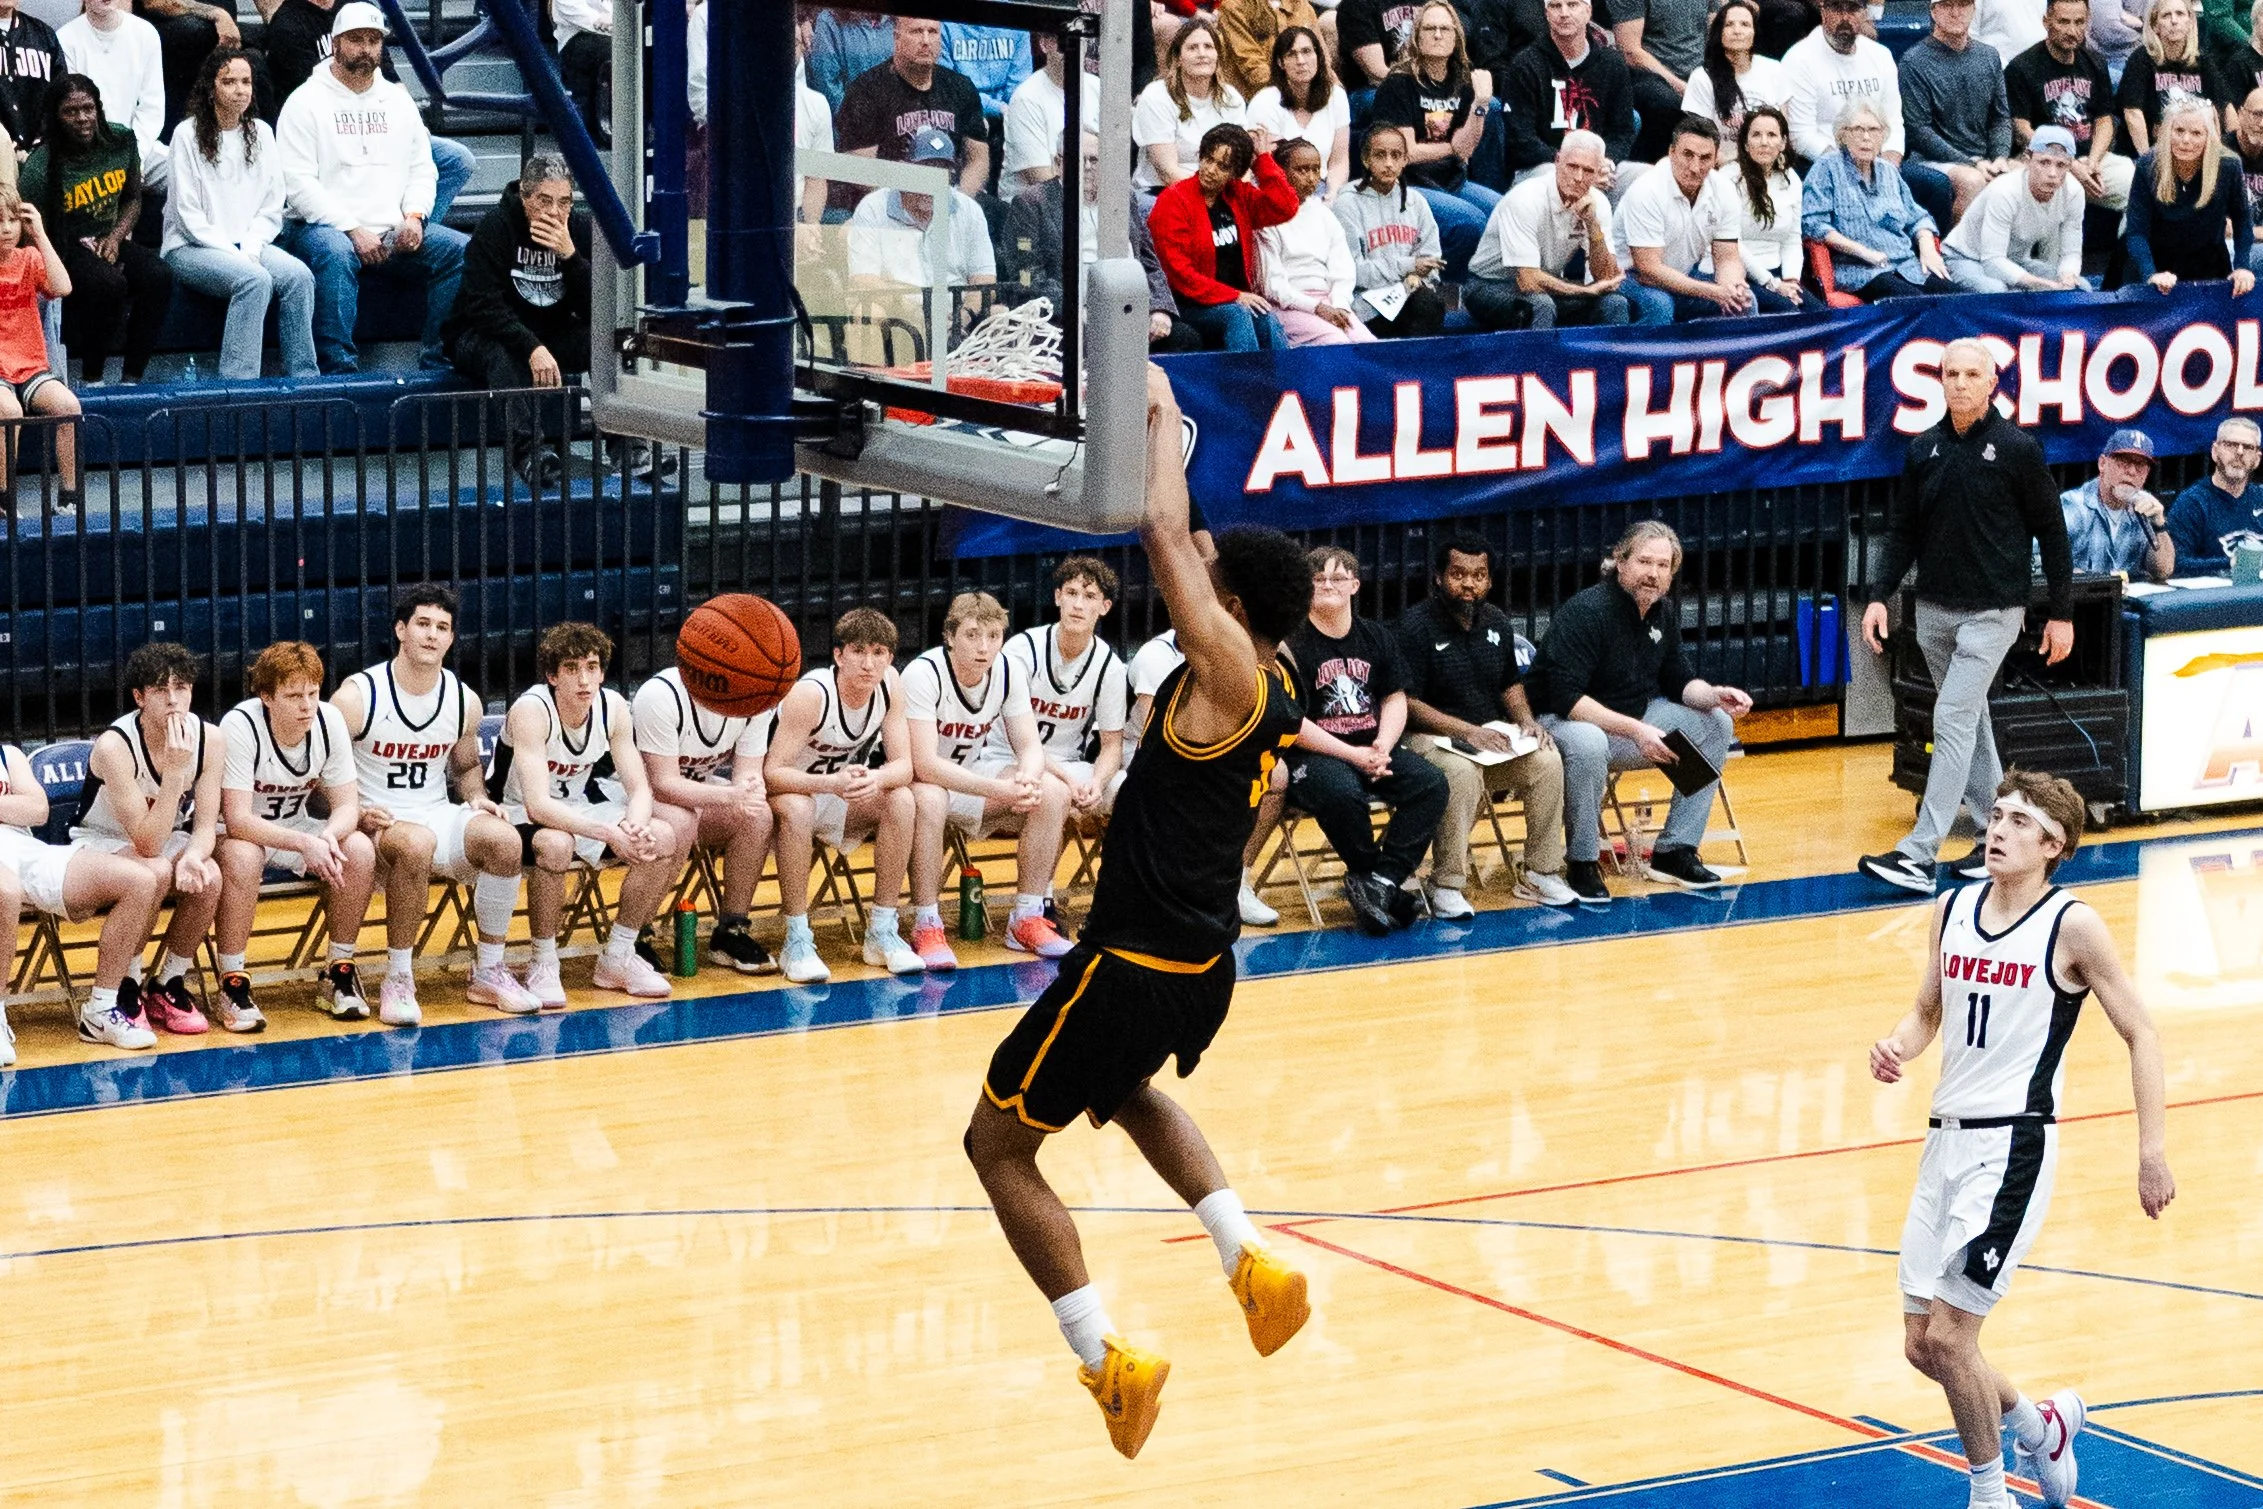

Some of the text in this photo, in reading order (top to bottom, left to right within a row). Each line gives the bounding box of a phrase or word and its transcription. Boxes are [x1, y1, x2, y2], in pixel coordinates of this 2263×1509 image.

[517, 246, 557, 267] LOVEJO
[1244, 368, 1597, 493] ALLEN
[1622, 345, 1867, 462] HIGH
[387, 762, 427, 789] 20
[261, 793, 307, 820] 33
[1942, 952, 2037, 988] LOVEJOY
[1966, 992, 1991, 1049] 11
